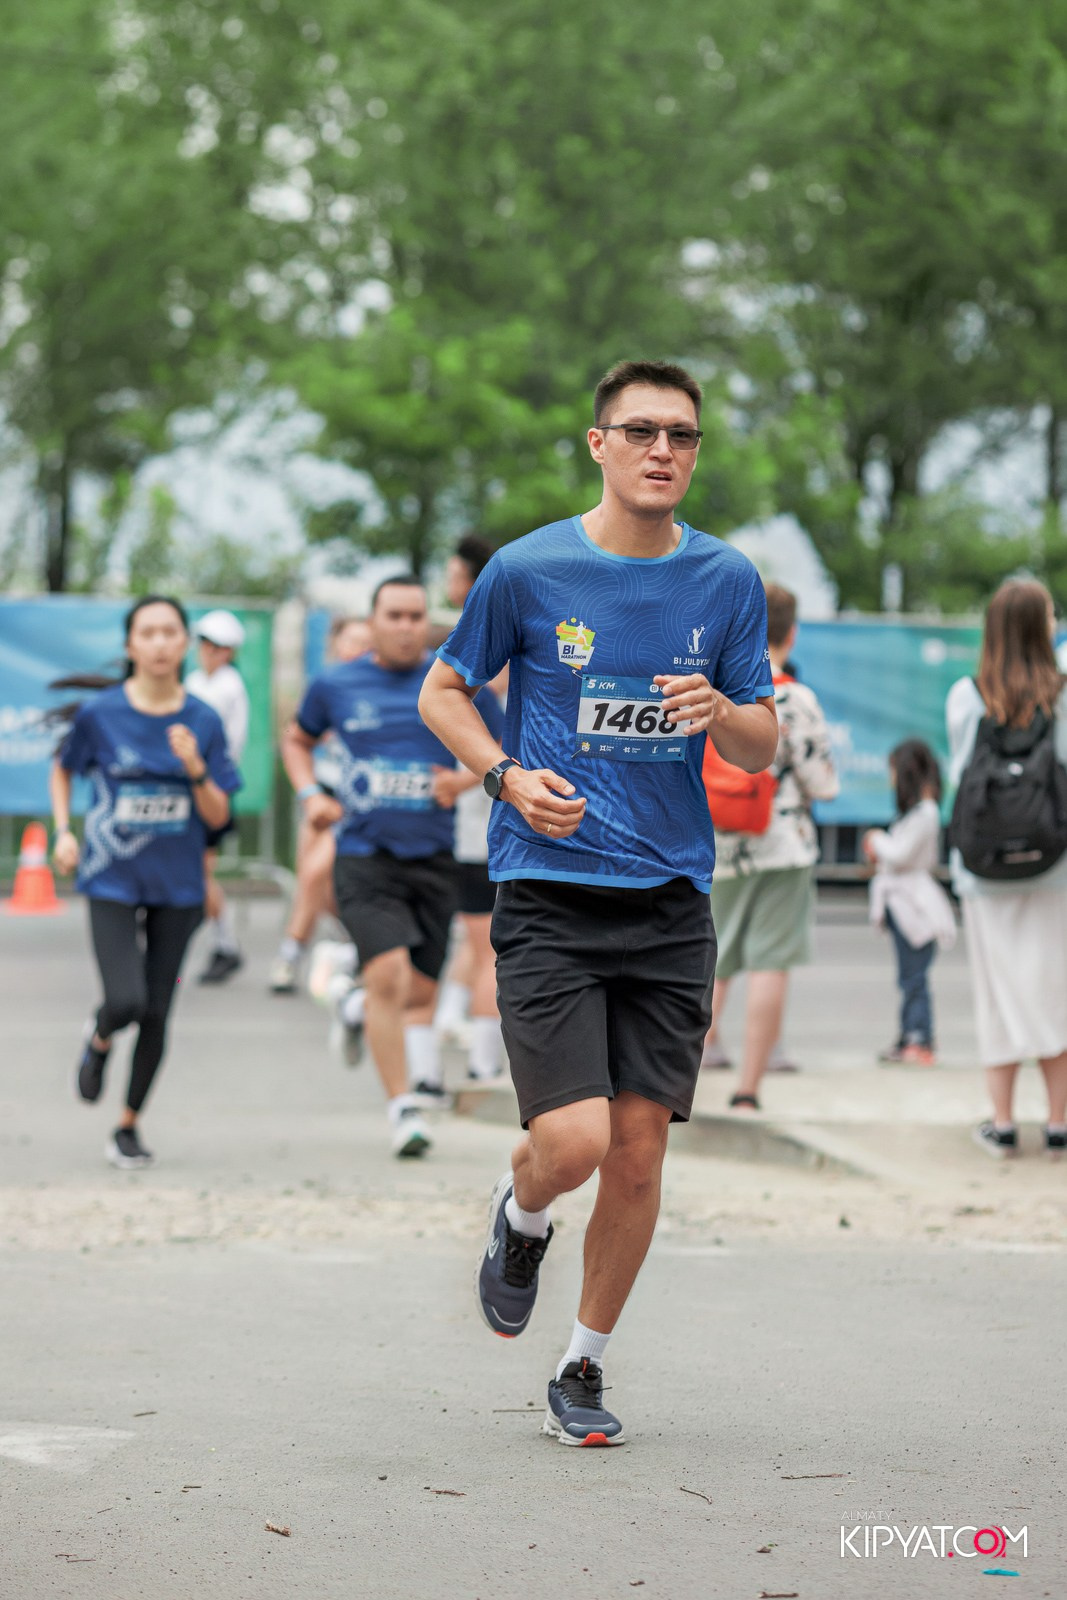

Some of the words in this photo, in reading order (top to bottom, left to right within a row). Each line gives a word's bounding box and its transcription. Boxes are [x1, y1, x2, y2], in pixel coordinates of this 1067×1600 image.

[563, 645, 575, 654] BI
[673, 657, 682, 665] BI
[587, 679, 597, 689] 5
[598, 682, 616, 690] KM
[592, 703, 680, 735] 1468
